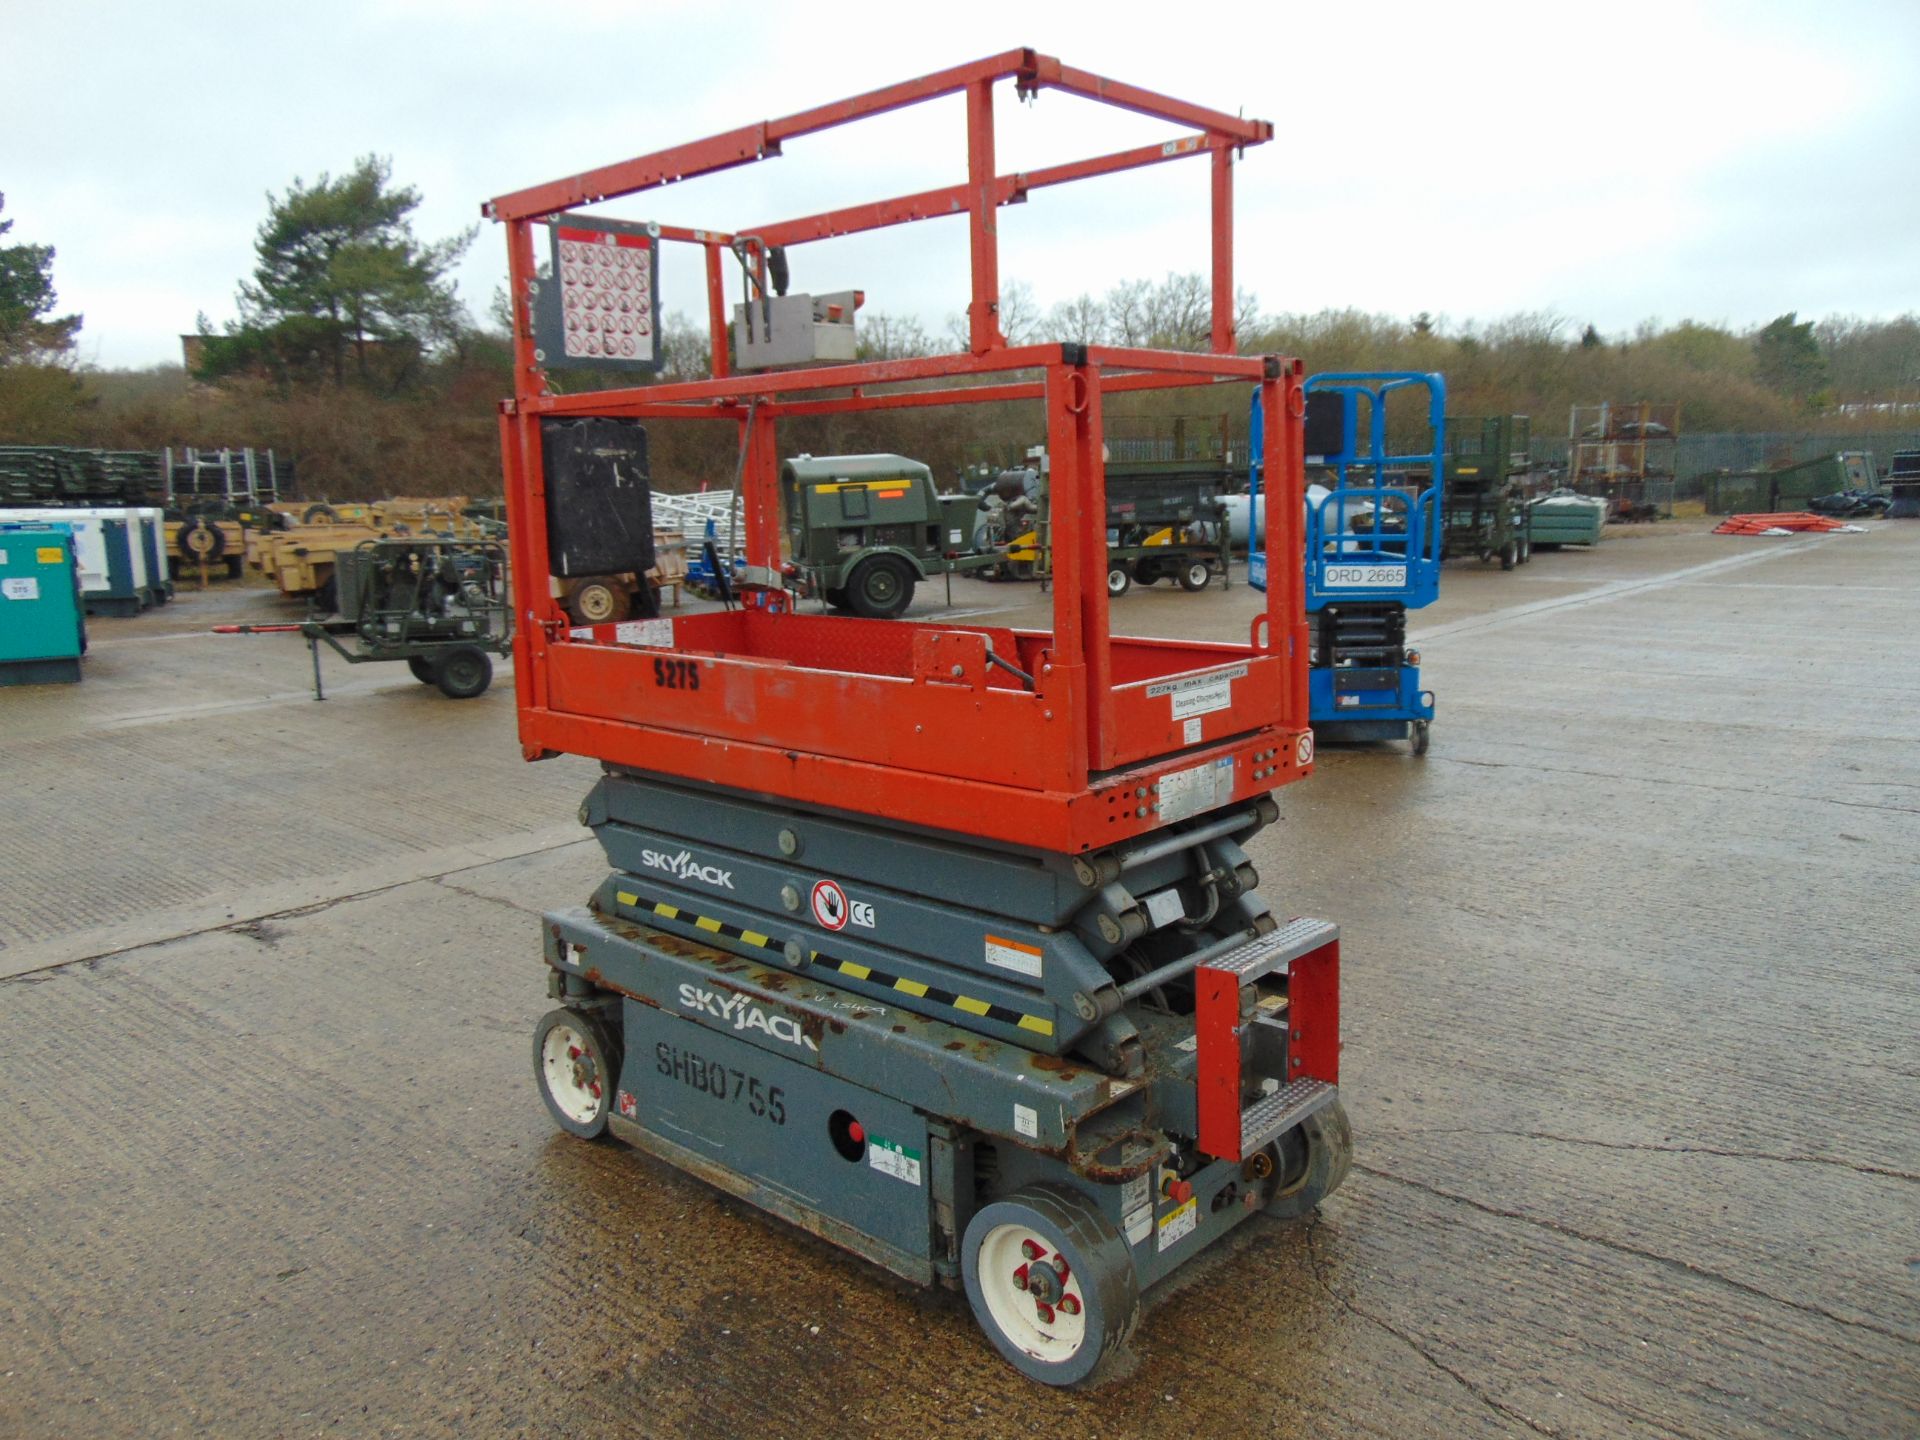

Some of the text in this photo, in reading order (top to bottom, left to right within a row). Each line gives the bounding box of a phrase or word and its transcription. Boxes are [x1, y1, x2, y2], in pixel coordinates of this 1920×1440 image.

[1326, 568, 1405, 582] ORD 2665
[1184, 679, 1203, 688] max
[1208, 669, 1246, 682] capacity
[641, 849, 735, 890] SKYJACK
